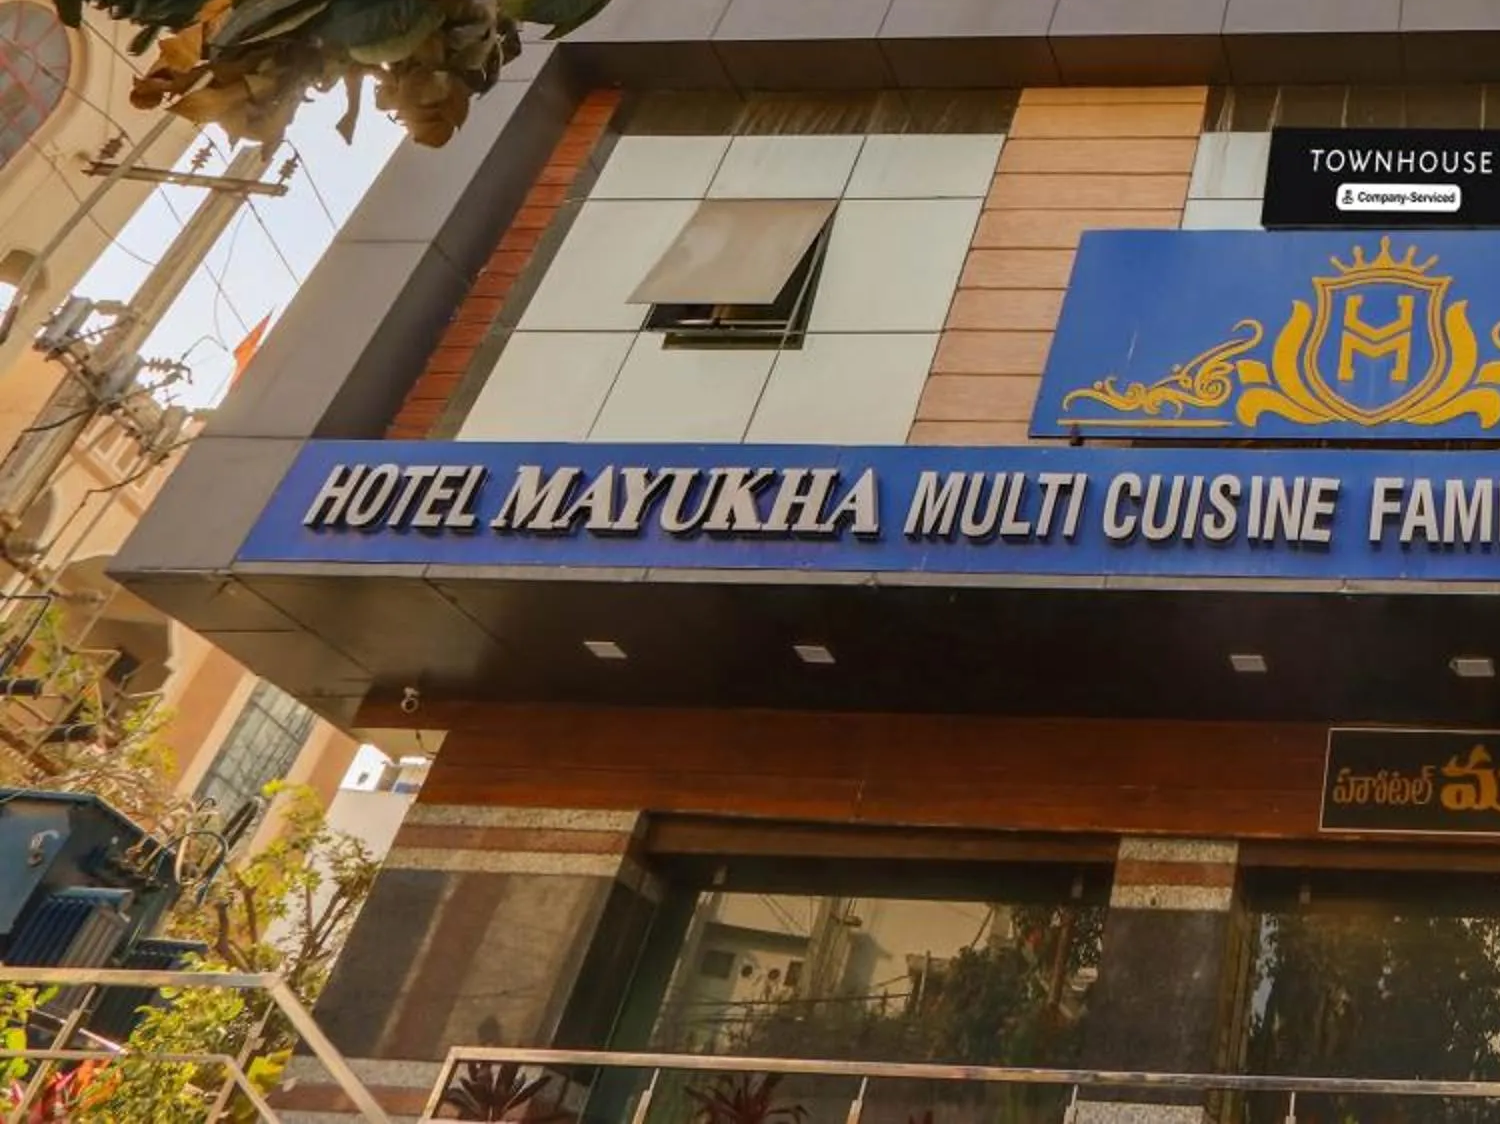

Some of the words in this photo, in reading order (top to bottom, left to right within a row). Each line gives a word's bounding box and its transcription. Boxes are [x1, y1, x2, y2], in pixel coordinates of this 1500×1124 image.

[1309, 148, 1494, 174] TOWNHOUSE
[1356, 190, 1456, 205] Company-Serviced
[302, 463, 490, 529] HOTEL
[490, 465, 884, 541] MAYUKHA
[903, 471, 1089, 541] MULTI
[1102, 473, 1340, 545] CUISINE
